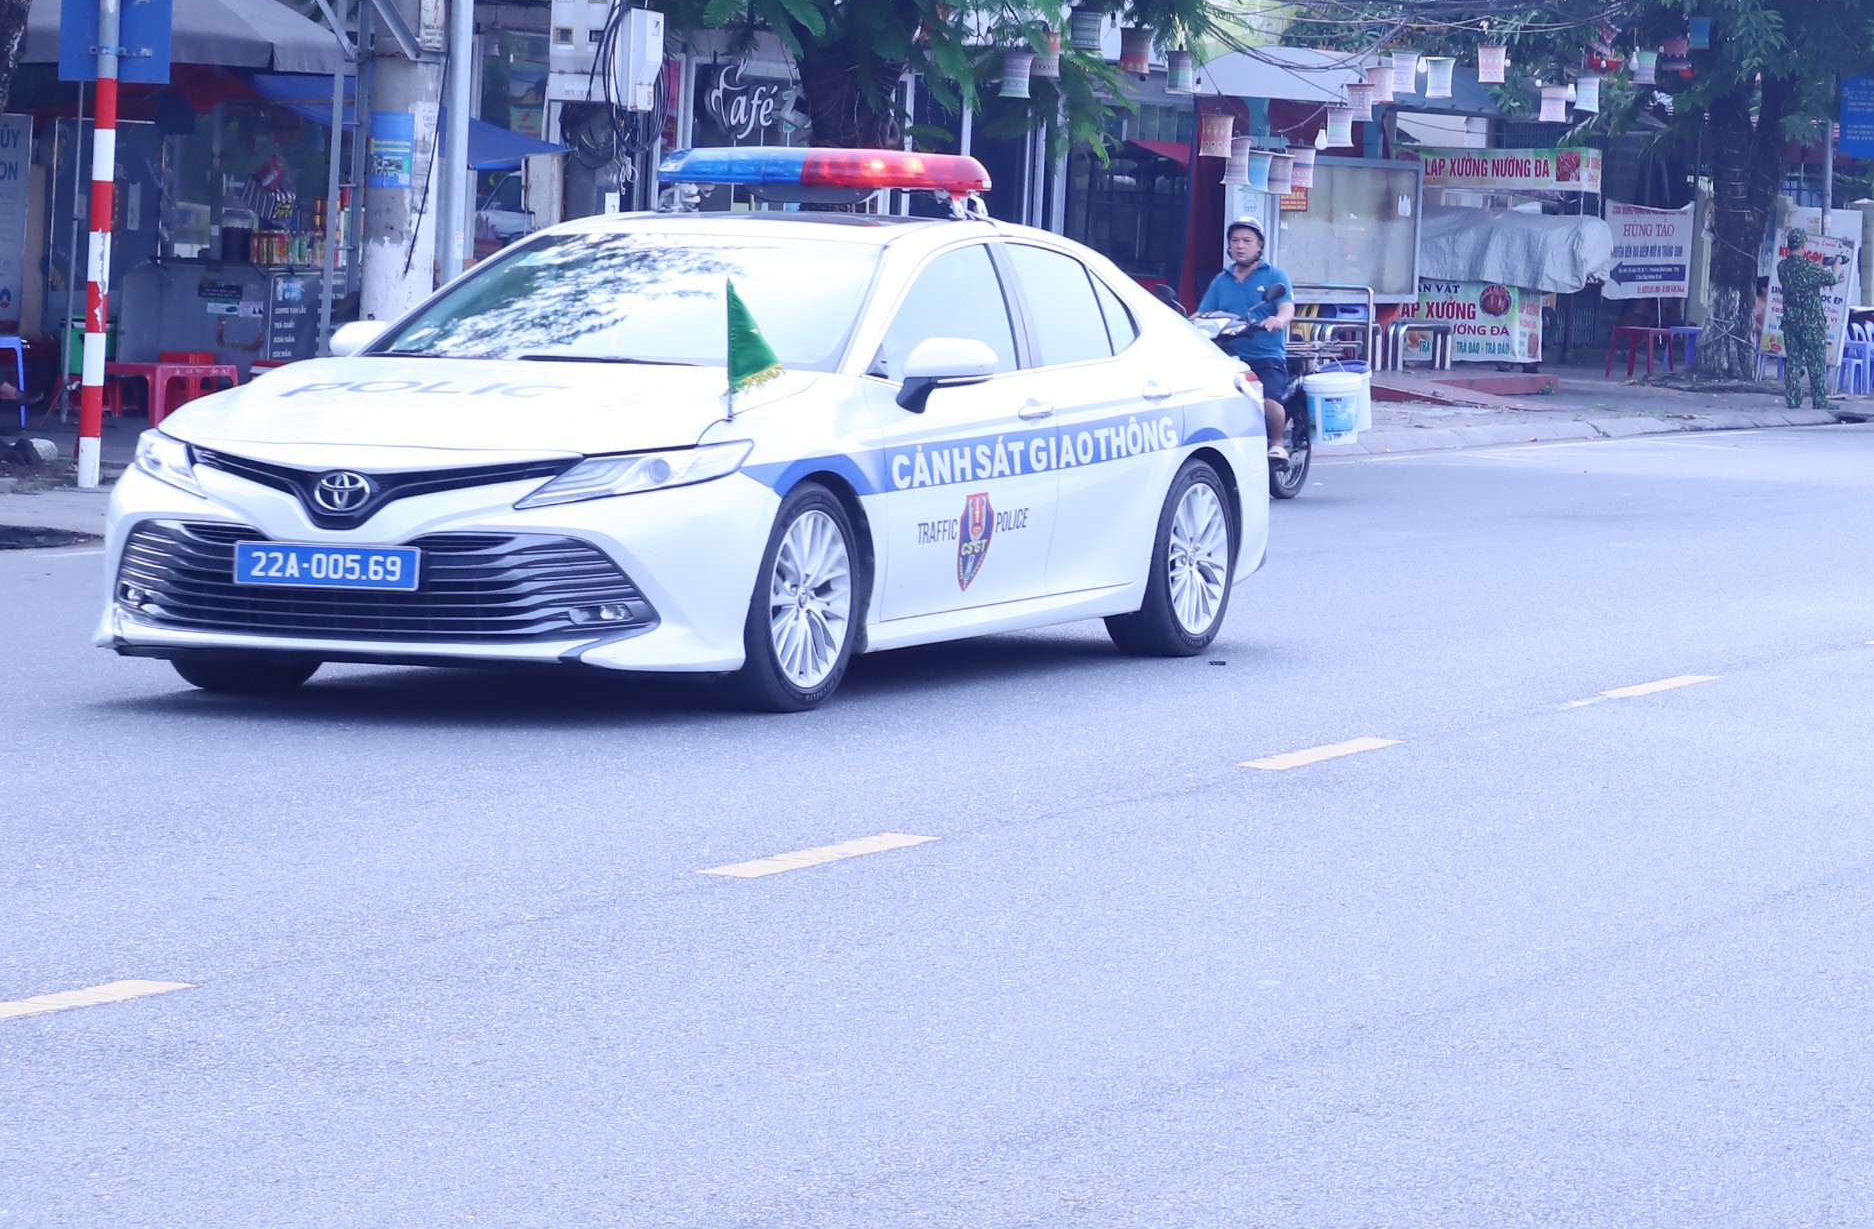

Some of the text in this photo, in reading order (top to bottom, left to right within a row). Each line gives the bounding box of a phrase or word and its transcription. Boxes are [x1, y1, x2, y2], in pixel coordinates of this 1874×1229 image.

[1424, 157, 1446, 180] LẠP
[1449, 152, 1488, 178] XƯỞNG
[1534, 155, 1550, 178] ĐÁ
[1623, 220, 1653, 237] HÙNG
[892, 415, 1179, 490] CẢNH SÁT GIAO THÔNG
[917, 518, 958, 545] TRAFFIC
[995, 507, 1029, 533] POLICE
[250, 551, 402, 582] 22A-005.69
